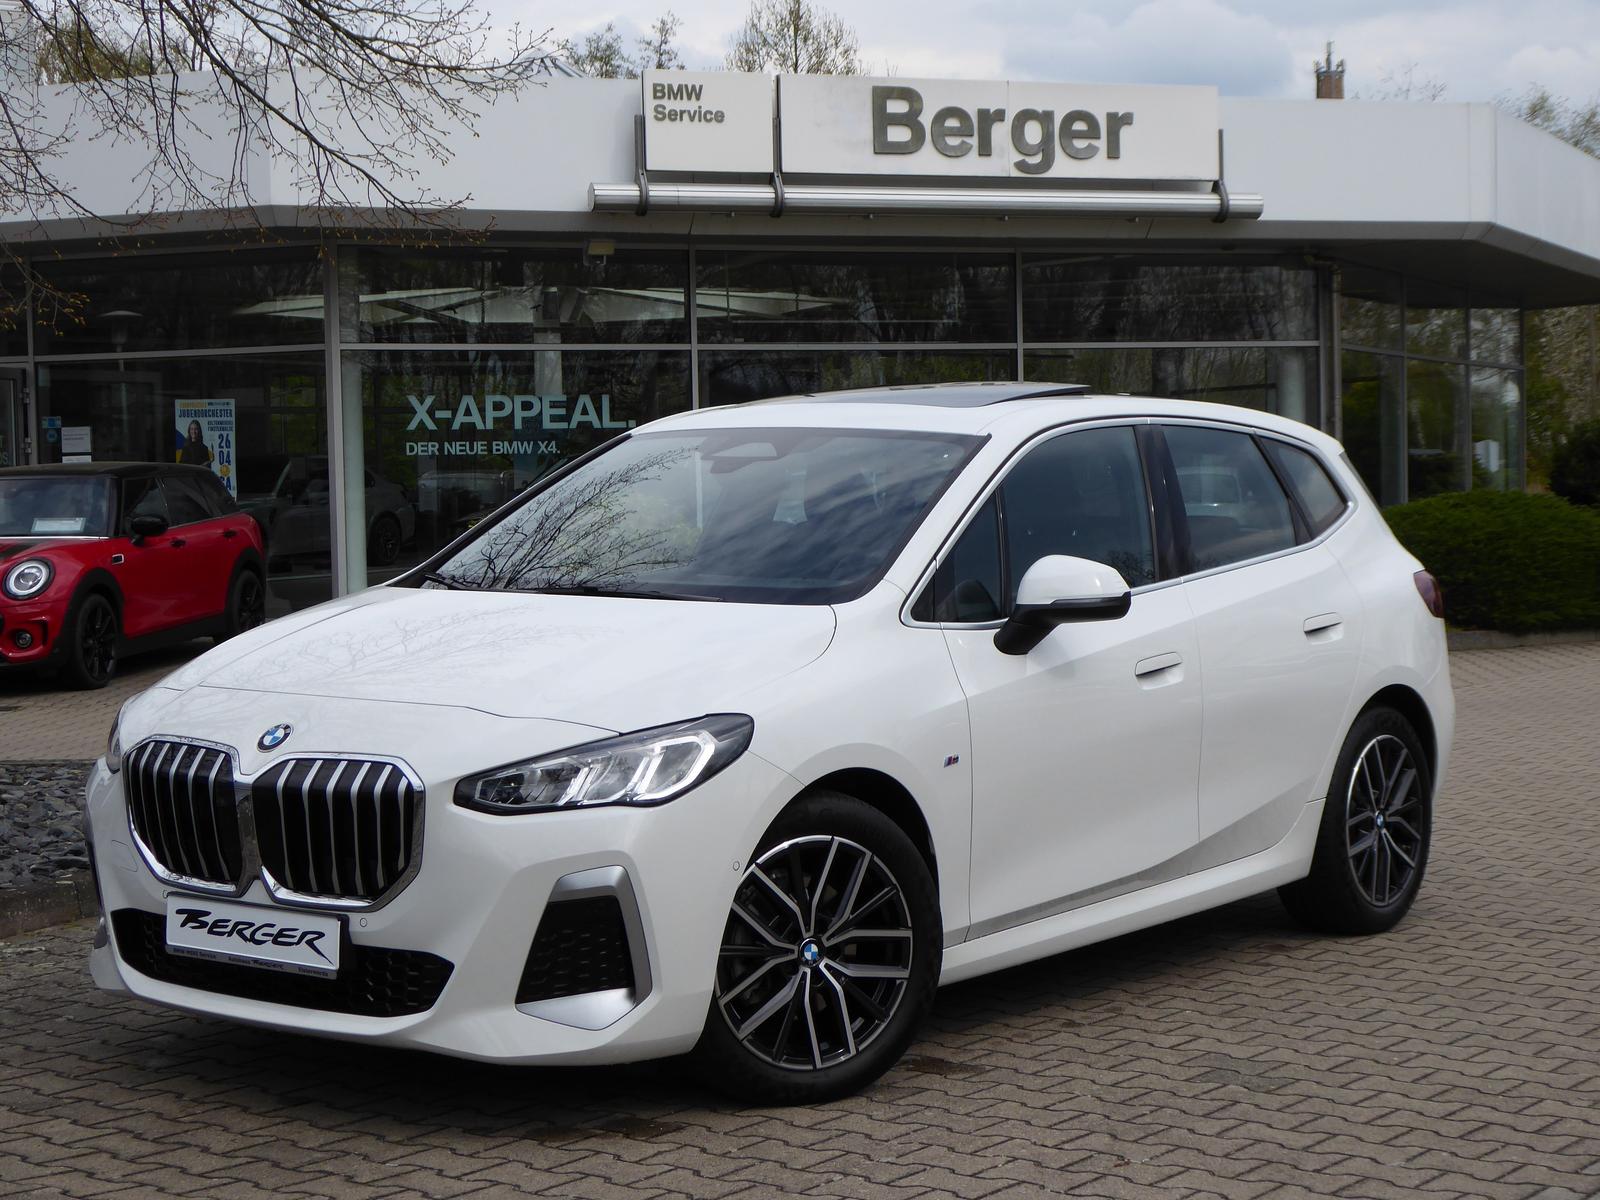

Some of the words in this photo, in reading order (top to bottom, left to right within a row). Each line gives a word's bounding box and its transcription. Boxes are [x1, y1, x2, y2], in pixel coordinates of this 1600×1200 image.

[652, 83, 704, 101] BMW
[653, 104, 726, 124] Service
[872, 85, 1134, 175] Berger
[406, 394, 637, 431] X-APPEAL.
[218, 433, 231, 449] 26
[406, 441, 440, 456] DER
[444, 441, 488, 455] NEUE
[492, 440, 534, 455] BMW
[537, 440, 561, 454] X4.
[219, 450, 232, 466] 04
[175, 908, 334, 966] BERGER
